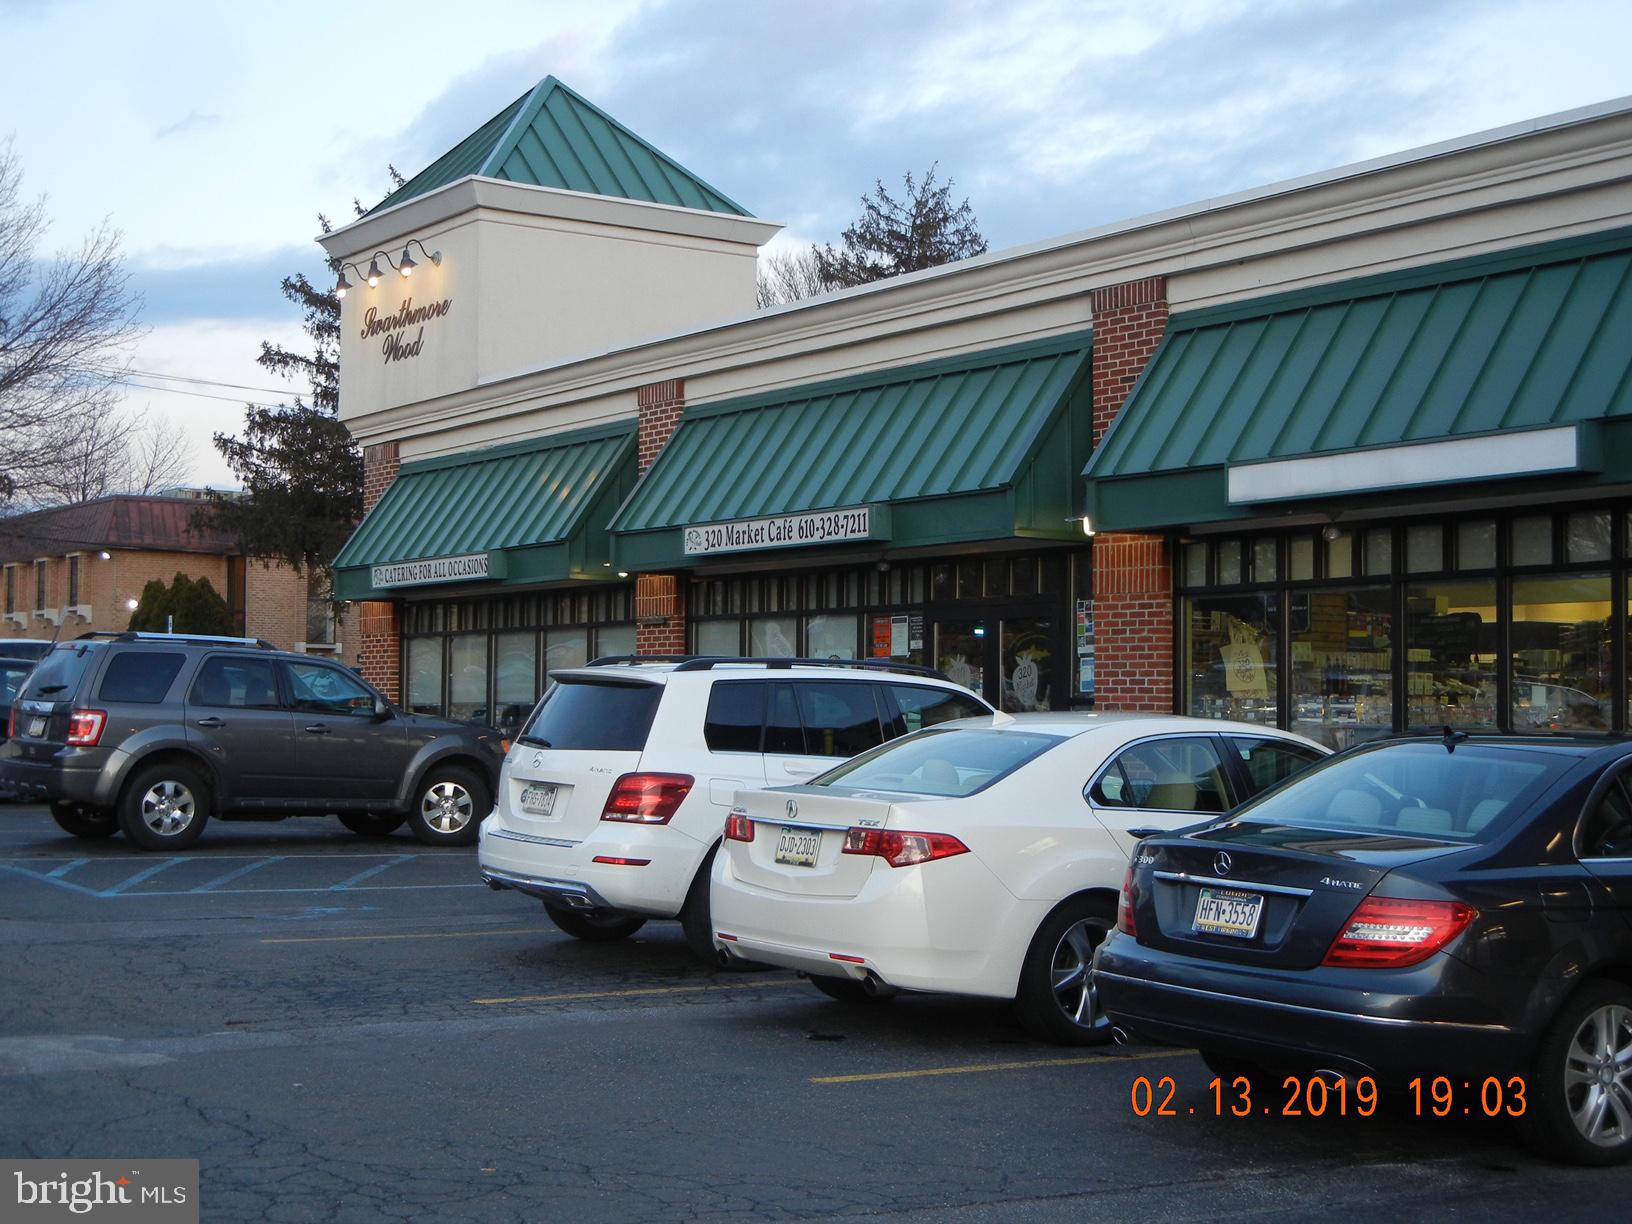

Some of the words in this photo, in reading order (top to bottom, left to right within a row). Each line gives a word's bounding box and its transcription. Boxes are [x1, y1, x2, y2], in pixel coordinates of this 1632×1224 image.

[382, 326, 424, 365] Wood
[704, 529, 723, 551] 320
[725, 523, 766, 547] Market
[768, 519, 793, 543] Café
[798, 512, 867, 540] 610-328-7211
[384, 565, 418, 583] CATERING
[419, 563, 432, 580] FOR
[433, 561, 447, 578] ALL
[448, 557, 488, 577] OCCASIONS
[1018, 664, 1032, 680] 320
[1320, 877, 1364, 890] 4MATIC
